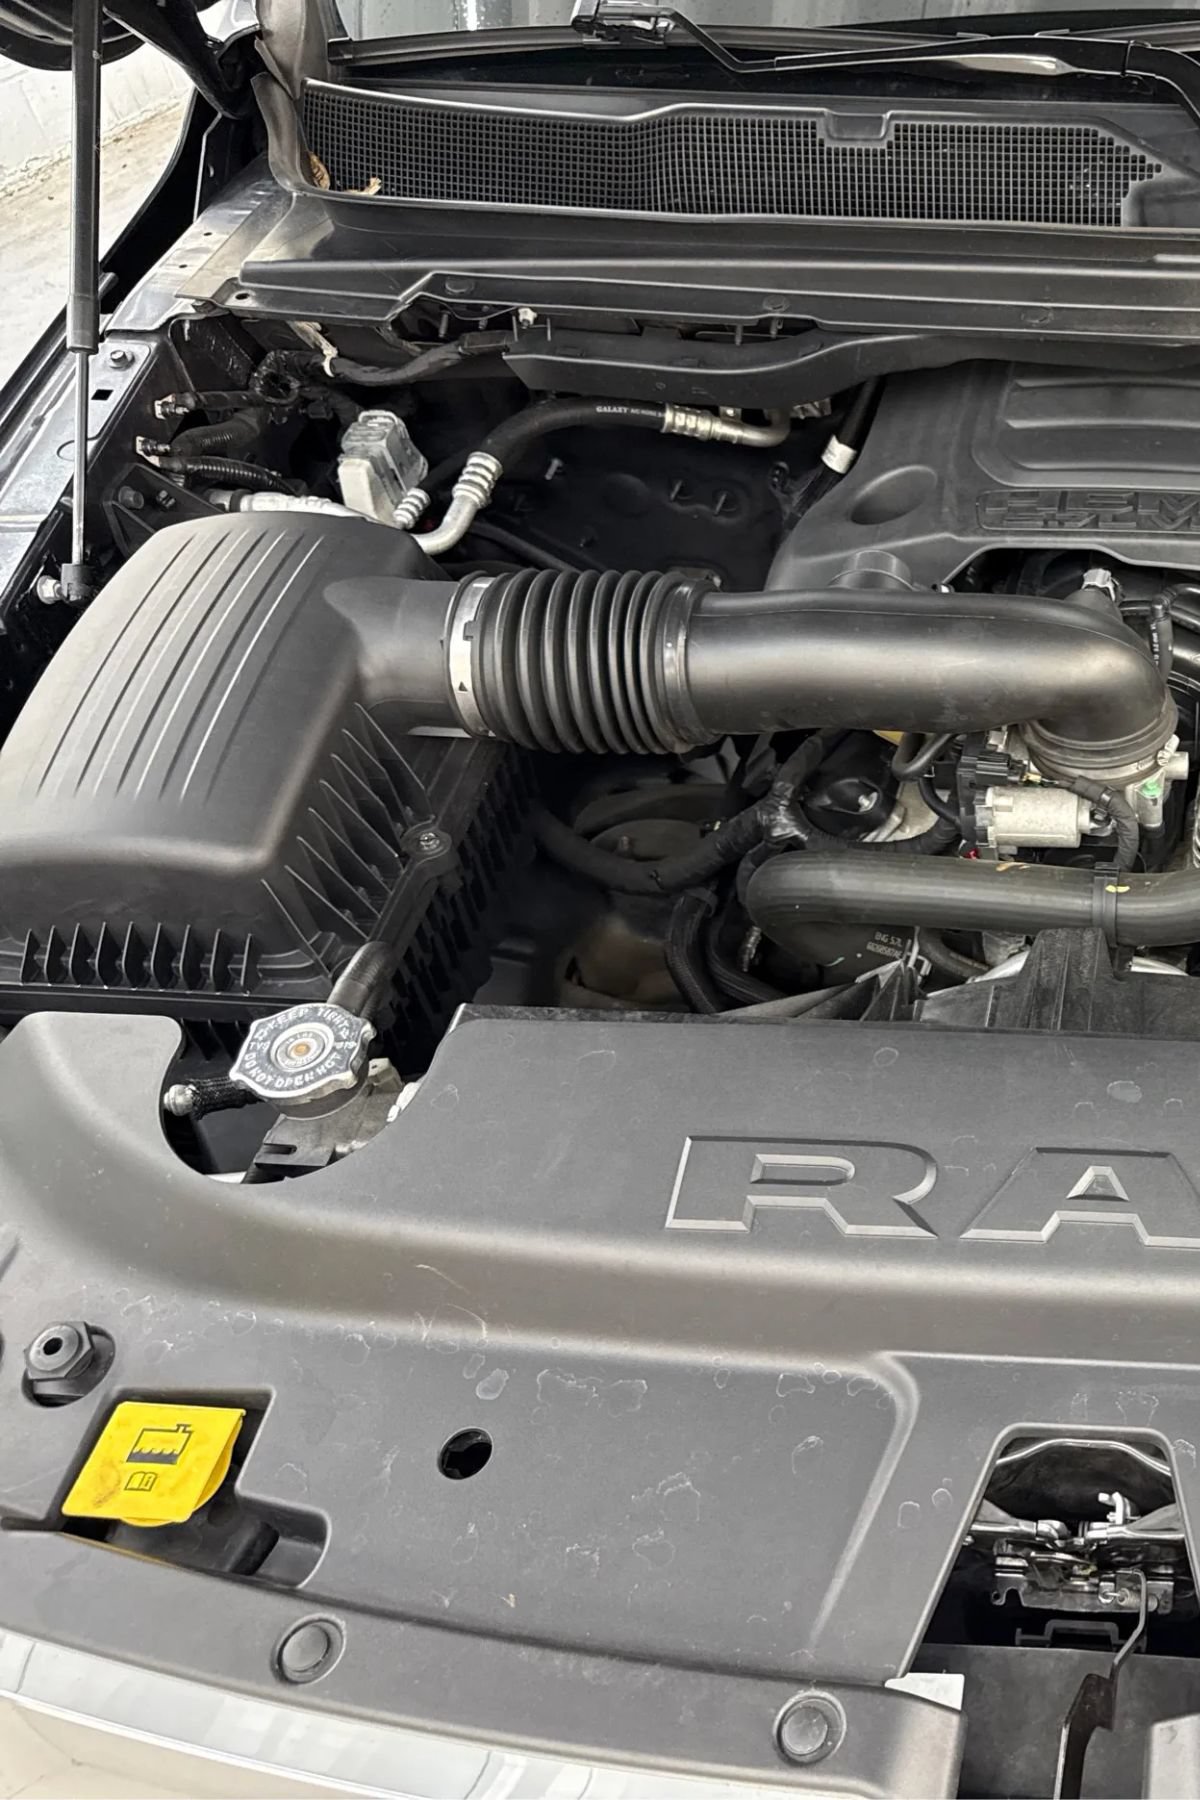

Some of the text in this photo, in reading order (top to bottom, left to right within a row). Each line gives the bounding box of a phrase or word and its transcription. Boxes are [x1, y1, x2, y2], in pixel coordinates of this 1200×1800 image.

[596, 405, 628, 414] GALAXY
[267, 1008, 350, 1030] KEEP TIGHT
